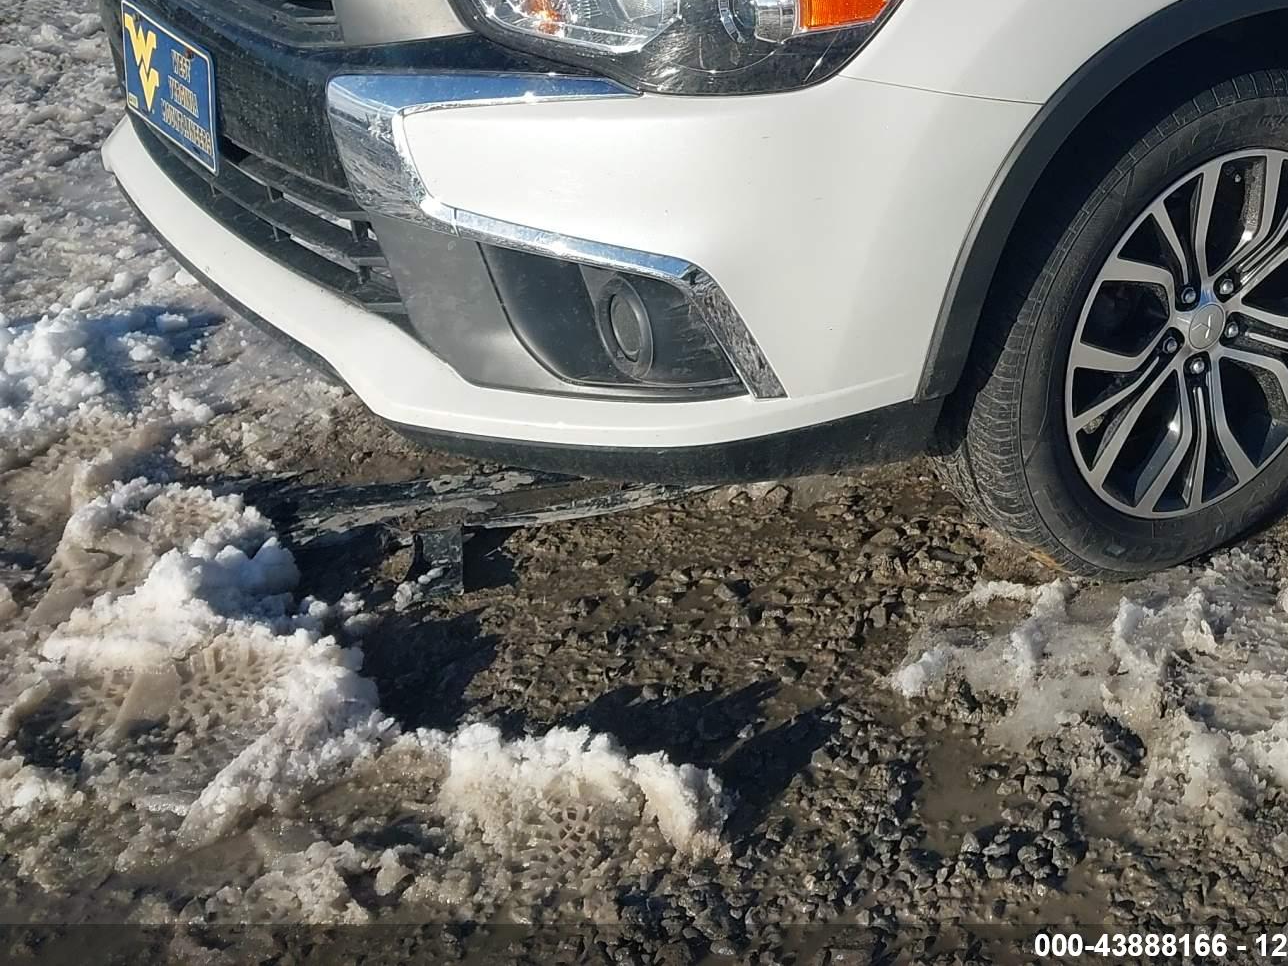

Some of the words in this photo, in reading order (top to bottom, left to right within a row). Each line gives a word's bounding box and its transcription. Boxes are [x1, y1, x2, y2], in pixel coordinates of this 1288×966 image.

[171, 48, 191, 84] WEST
[167, 74, 199, 119] VIRGINIA
[160, 97, 212, 157] MOUNTAINEERS
